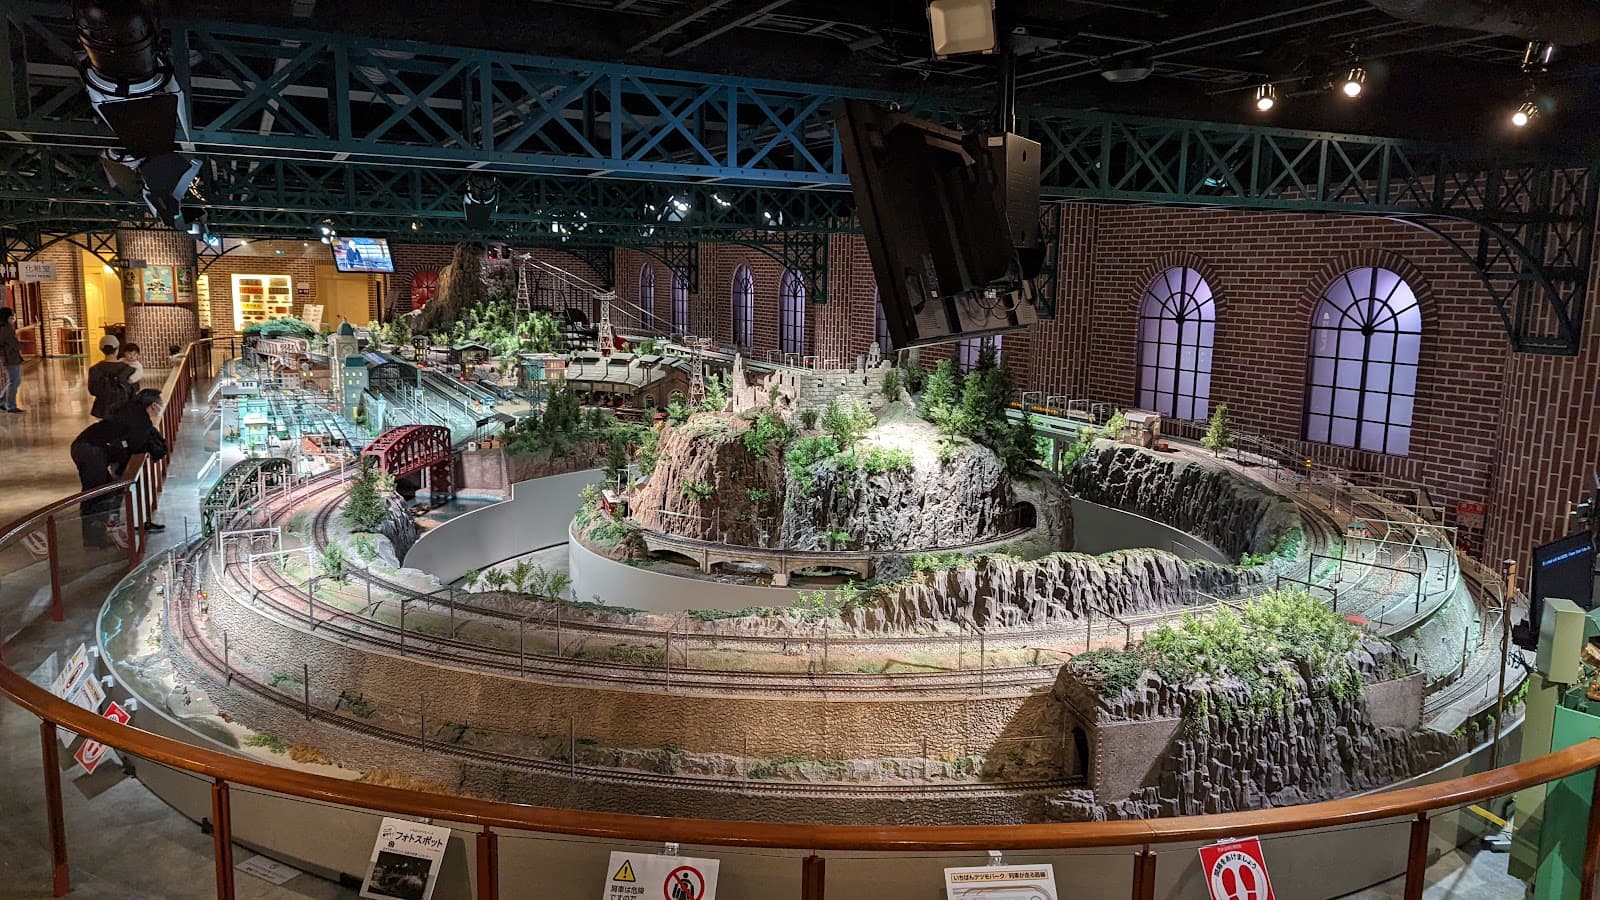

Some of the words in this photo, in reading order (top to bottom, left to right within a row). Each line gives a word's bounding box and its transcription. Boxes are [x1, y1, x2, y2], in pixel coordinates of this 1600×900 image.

[395, 831, 443, 849] フォトスポット
